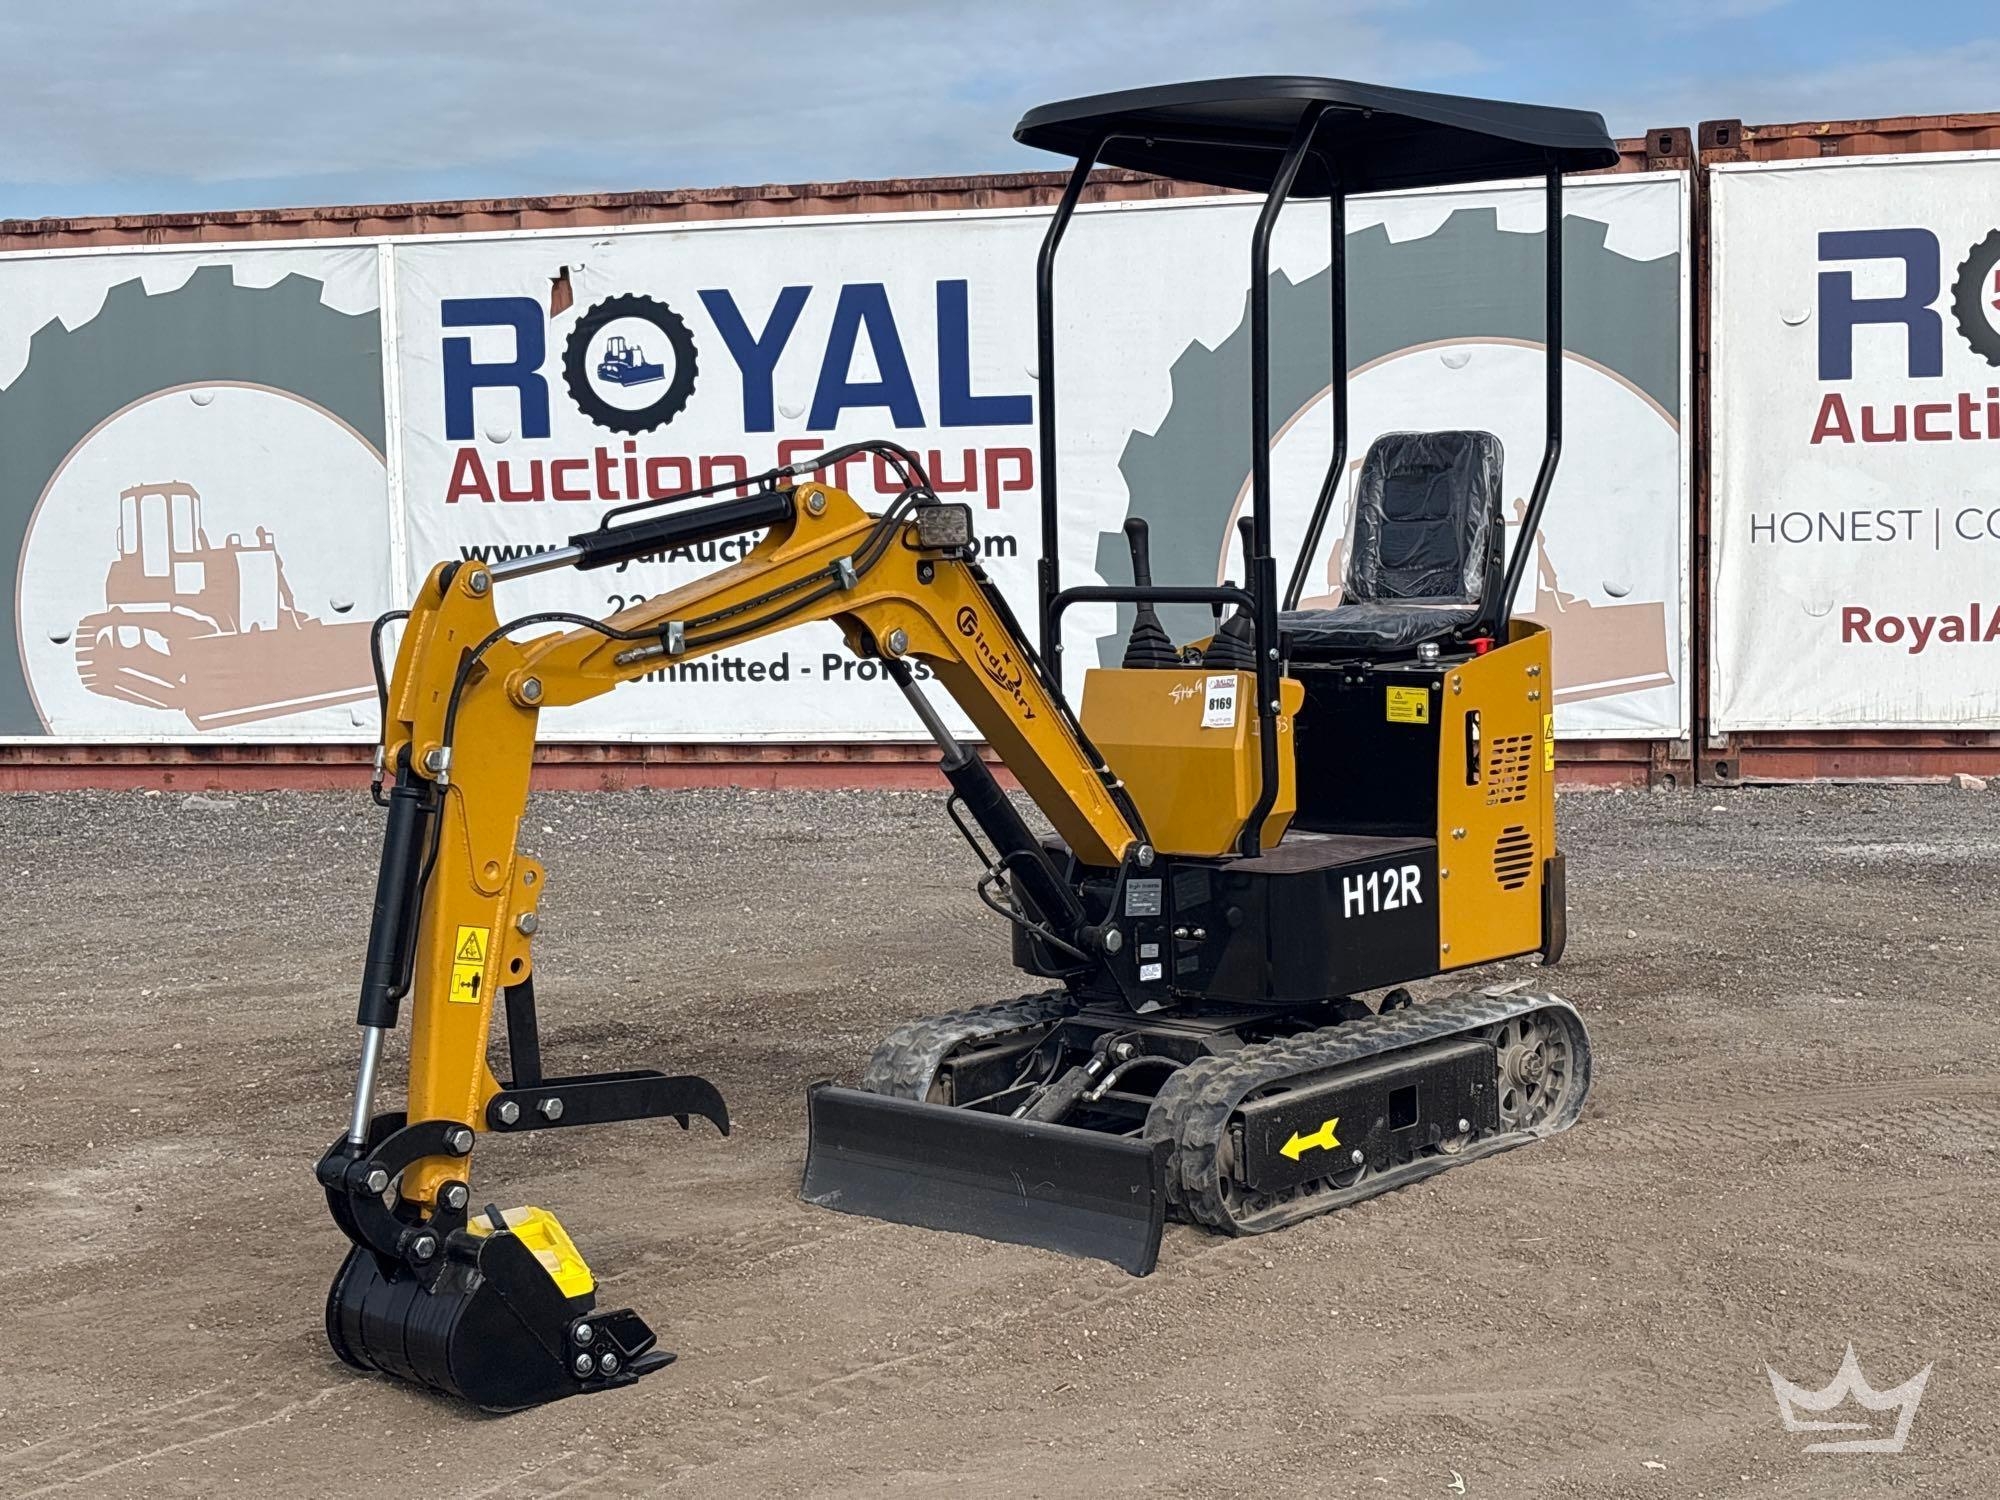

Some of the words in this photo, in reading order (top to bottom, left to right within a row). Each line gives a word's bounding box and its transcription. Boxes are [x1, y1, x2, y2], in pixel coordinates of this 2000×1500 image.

[441, 279, 1033, 441] ROYAL
[446, 440, 746, 503] Auction
[1751, 510, 1923, 543] HONEST
[1209, 697, 1232, 710] 8169
[1343, 865, 1423, 918] H12R
